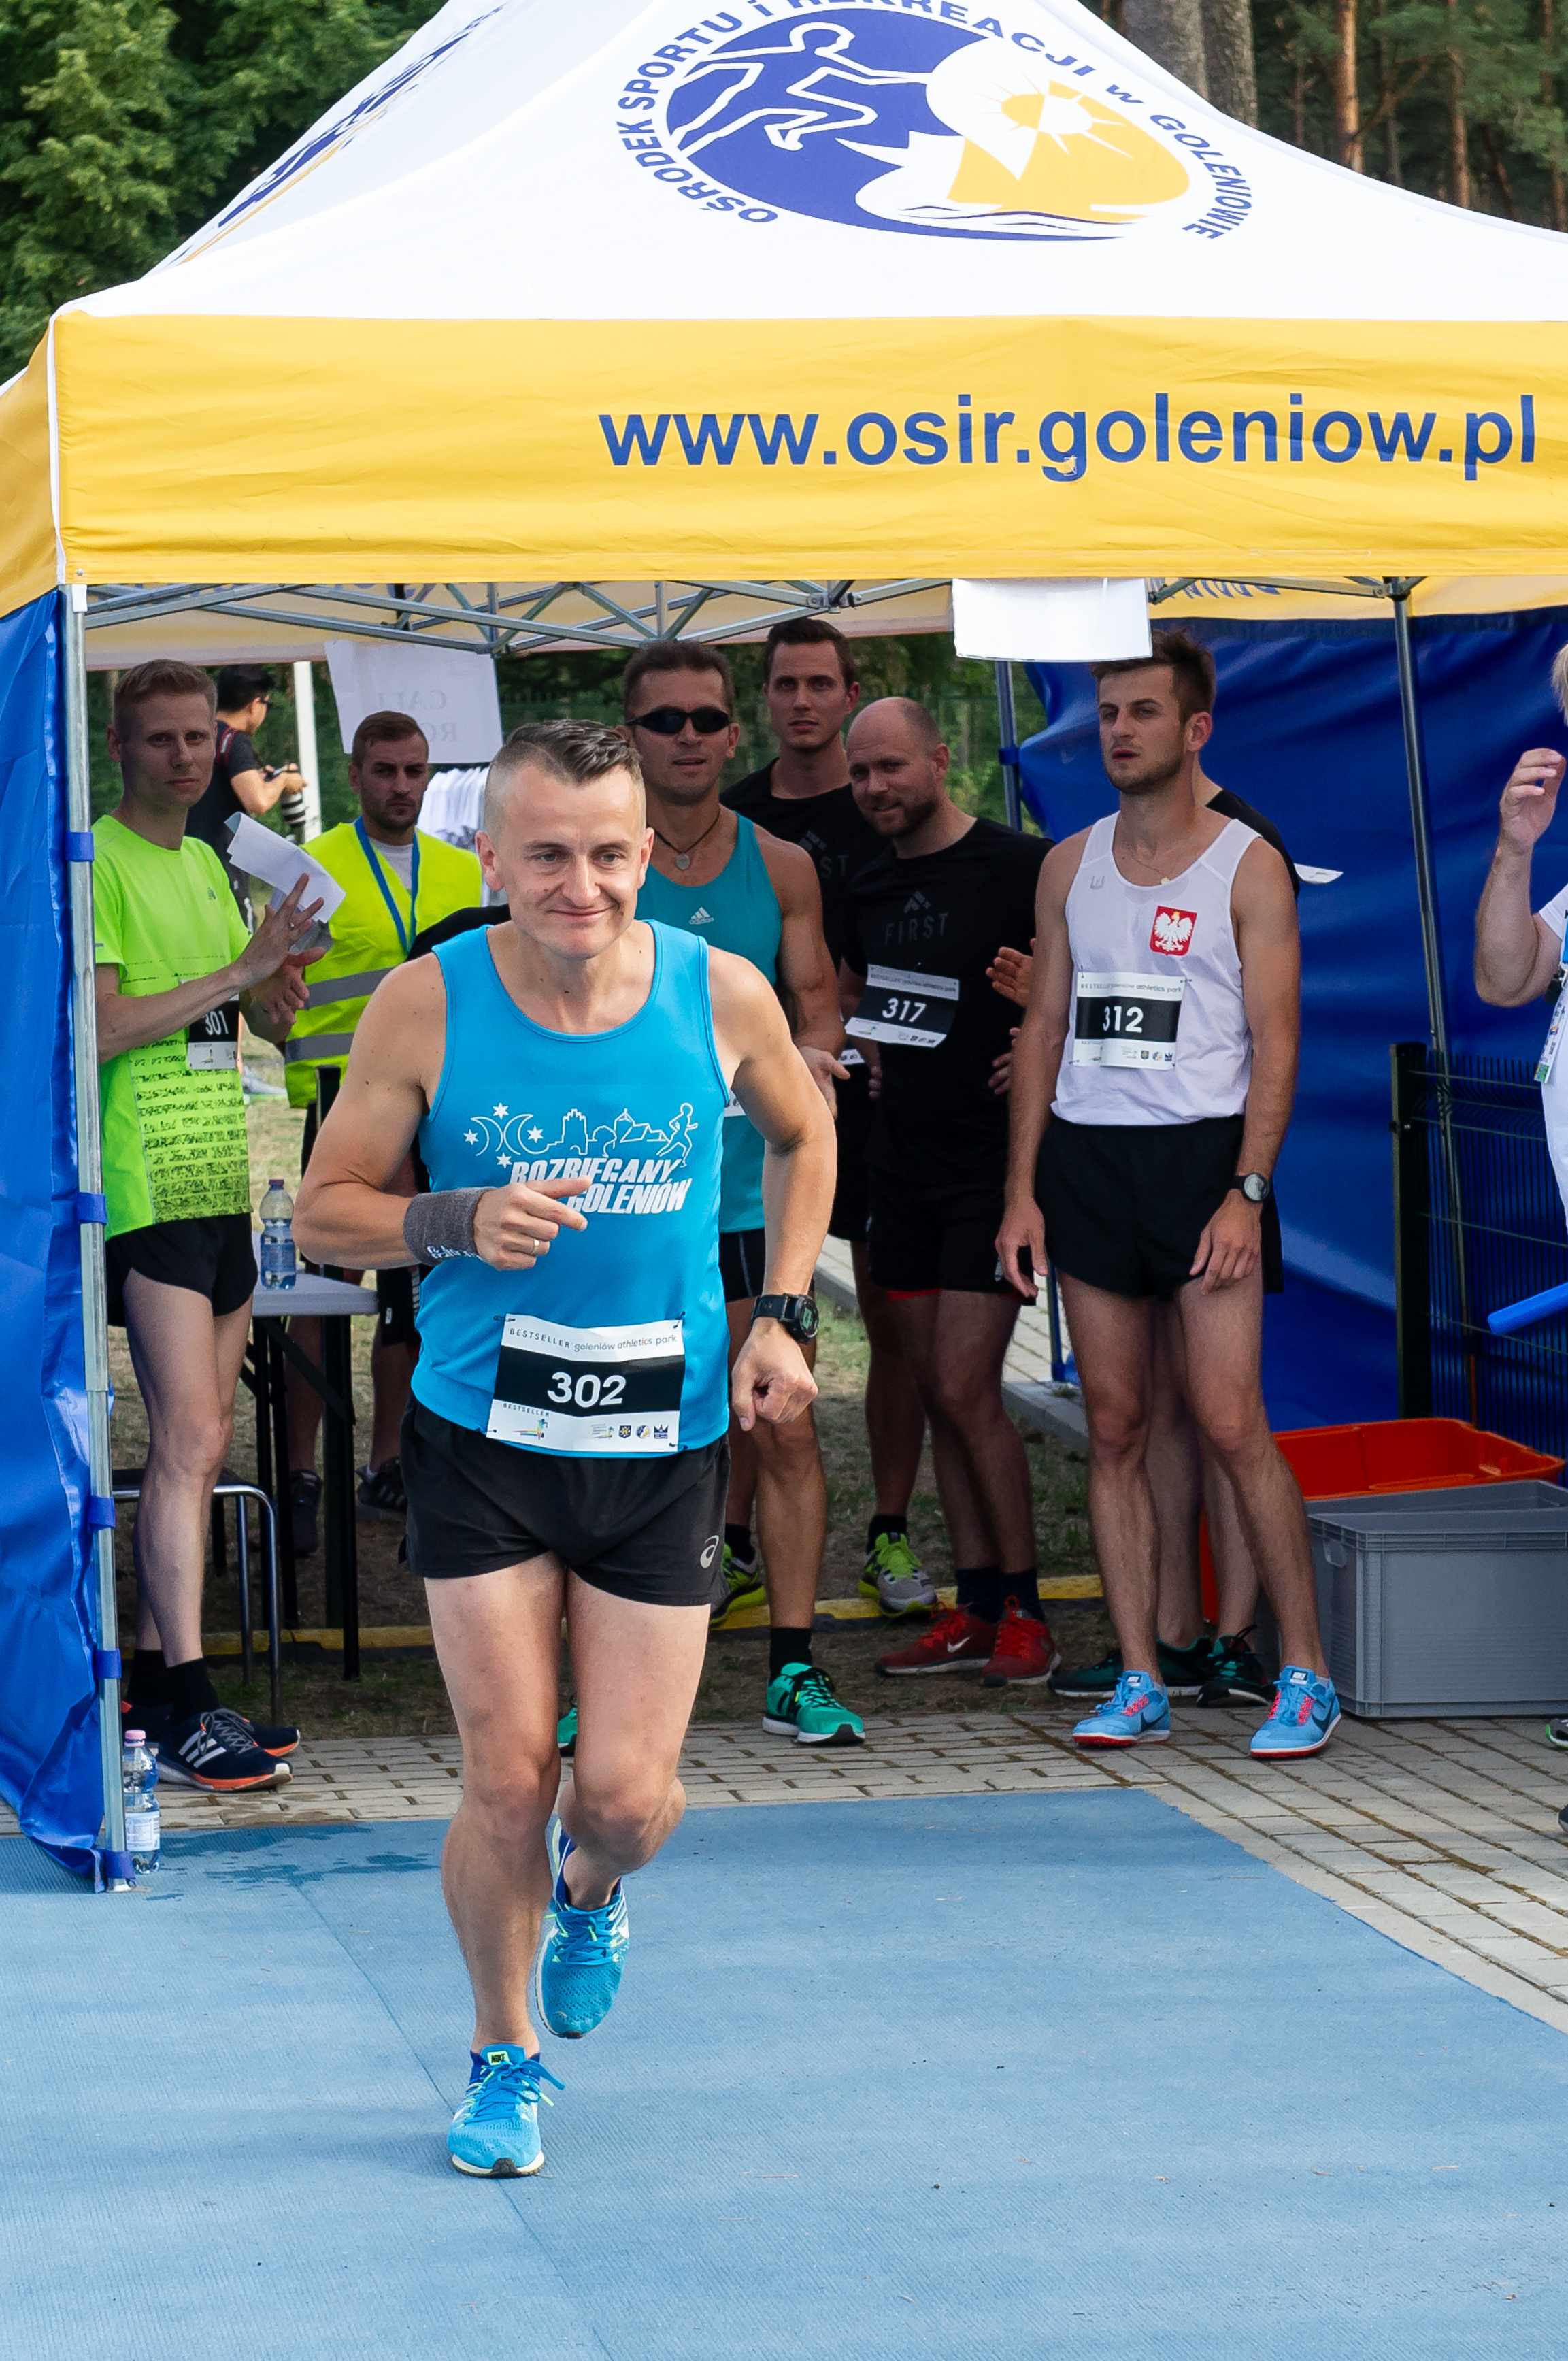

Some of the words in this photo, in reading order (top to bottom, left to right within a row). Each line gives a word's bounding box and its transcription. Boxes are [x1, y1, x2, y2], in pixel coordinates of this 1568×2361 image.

[787, 0, 1096, 76] REACJI
[618, 12, 743, 110] SPORTU
[616, 118, 778, 222] OŚRODEK
[1150, 114, 1252, 239] GOLENIOWIE
[598, 392, 1535, 482] www.osir.goleniow.pl
[885, 912, 948, 946] FIRST
[202, 1010, 229, 1036] 301
[882, 997, 927, 1023] 317
[1103, 1006, 1144, 1033] 312
[510, 1327, 570, 1349] BESTSELLER
[573, 1341, 615, 1353] goleniów
[617, 1338, 653, 1350] athletics
[655, 1334, 677, 1346] park
[547, 1372, 627, 1408] 302
[503, 1403, 550, 1417] BESTSELLER
